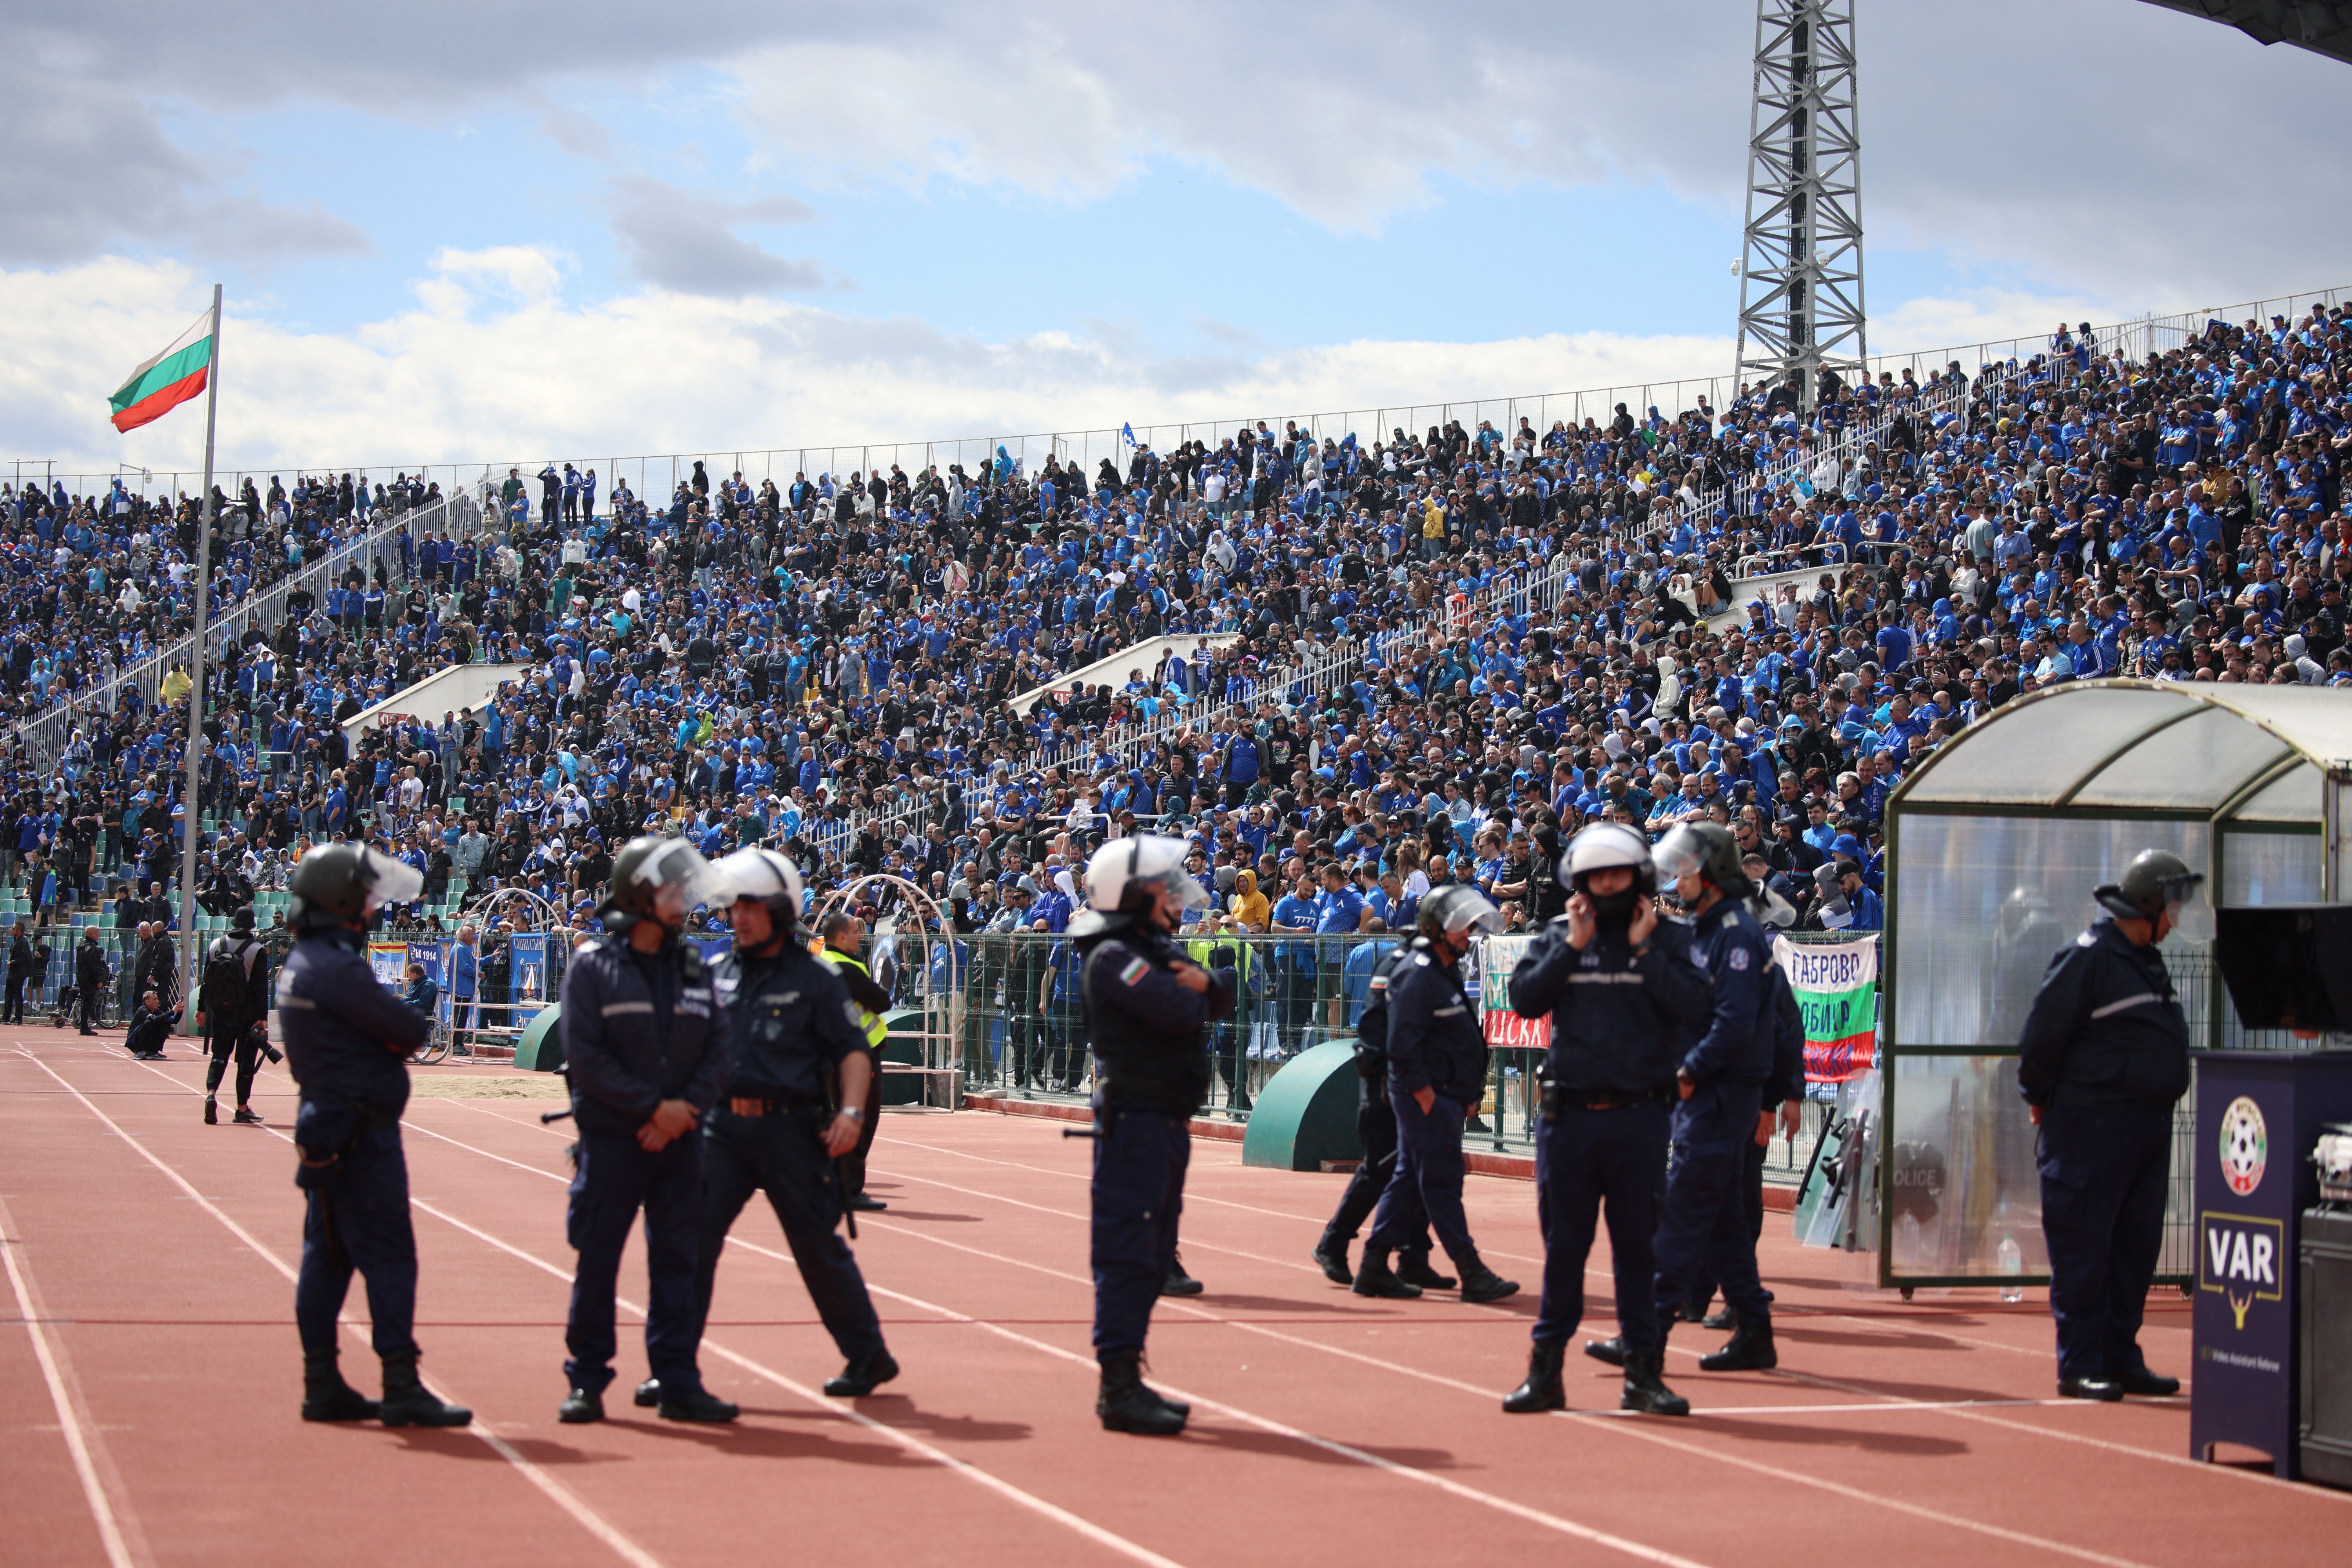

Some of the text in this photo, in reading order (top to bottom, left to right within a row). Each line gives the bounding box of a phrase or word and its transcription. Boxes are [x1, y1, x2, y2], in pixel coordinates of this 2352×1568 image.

[1294, 916, 1316, 926] 7777
[514, 937, 530, 951] СИНИ
[423, 950, 436, 962] 1914
[1792, 953, 1860, 984] ГАБРОВО
[1492, 1011, 1542, 1046] ЦСКА
[2208, 1227, 2274, 1284] VAR
